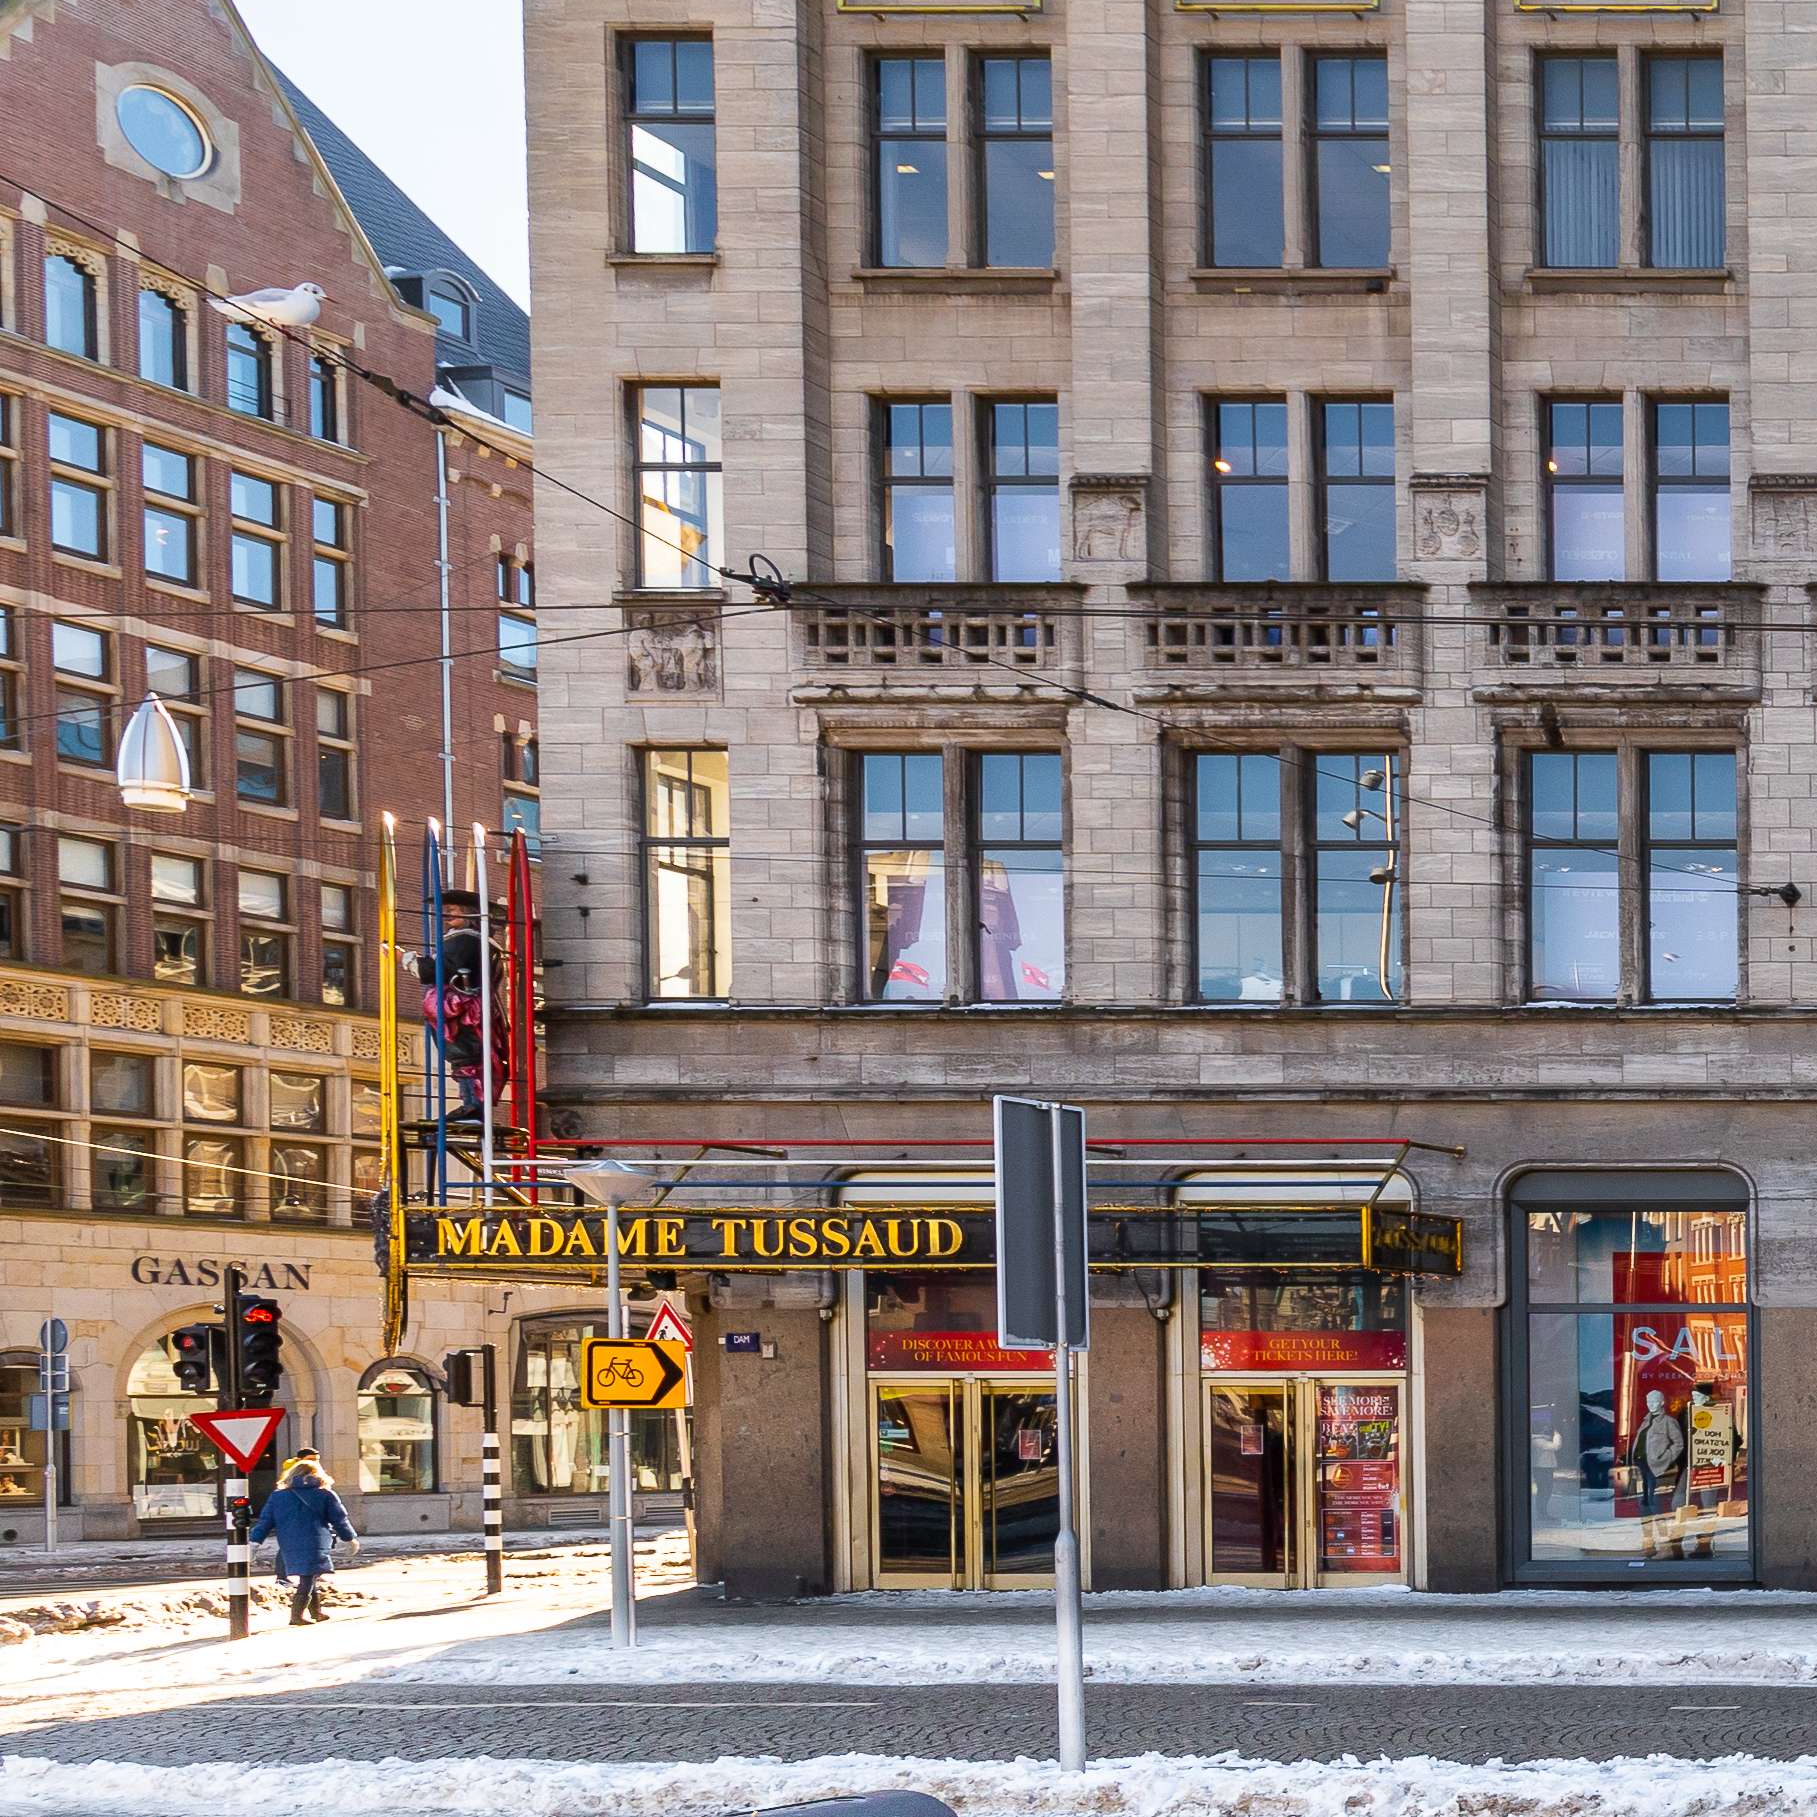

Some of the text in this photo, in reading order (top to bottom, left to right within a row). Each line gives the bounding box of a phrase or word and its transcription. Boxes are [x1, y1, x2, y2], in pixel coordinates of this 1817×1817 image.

[436, 1217, 964, 1257] MADAME TUSSAUD
[131, 1255, 313, 1291] GASSAN
[733, 1335, 750, 1344] DAM
[902, 1339, 973, 1351] DISCOVER
[1269, 1339, 1340, 1349] GET YOUR
[914, 1351, 1029, 1362] OF FAMOUS FUN
[1254, 1350, 1358, 1361] TICKETS HERE!
